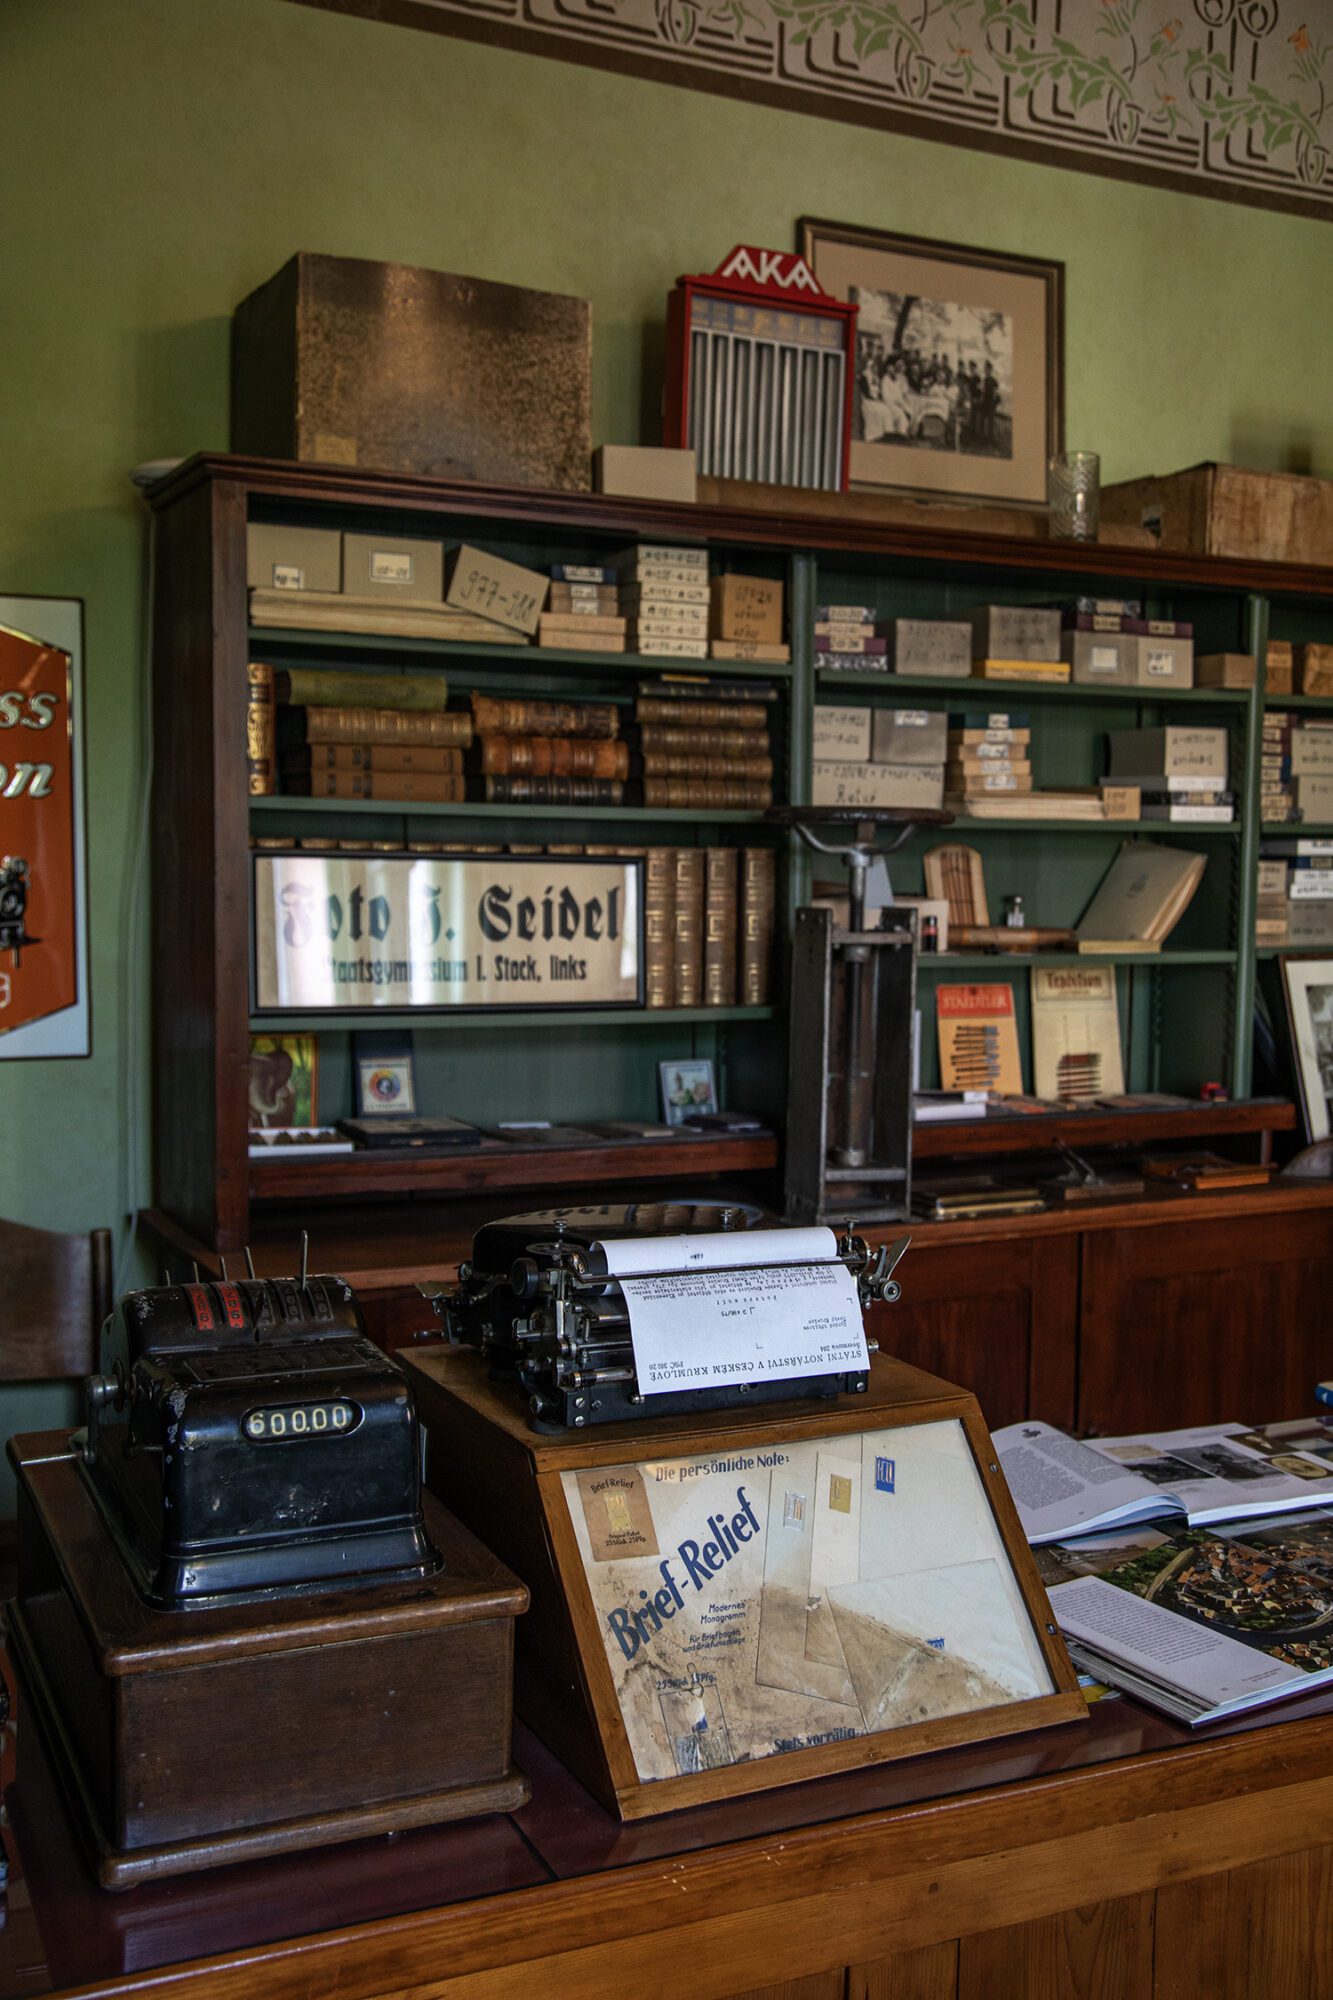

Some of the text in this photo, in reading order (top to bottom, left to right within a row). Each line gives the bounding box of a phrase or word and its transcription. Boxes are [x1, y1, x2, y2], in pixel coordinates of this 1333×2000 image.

[721, 247, 821, 295] AKA
[0, 690, 59, 731] ss
[280, 881, 392, 949] Foto
[477, 883, 621, 943] Seidel
[322, 954, 468, 985] taatsgymsium
[494, 954, 542, 983] Stock,
[549, 954, 588, 982] links
[768, 1354, 823, 1369] NOTÁŘSTVÍ
[828, 1350, 862, 1362] STÁTNÍ
[649, 1366, 708, 1381] KRUMLOVĚ
[712, 1361, 755, 1375] ČESKÉM
[655, 1451, 790, 1483] Die persönliche Note:
[590, 1477, 635, 1494] Brief-Relief
[606, 1485, 761, 1662] Brief-Relief
[708, 1600, 746, 1614] Modernes
[700, 1611, 746, 1625] Monogramm
[689, 1633, 700, 1643] für
[773, 1736, 805, 1752] Stets
